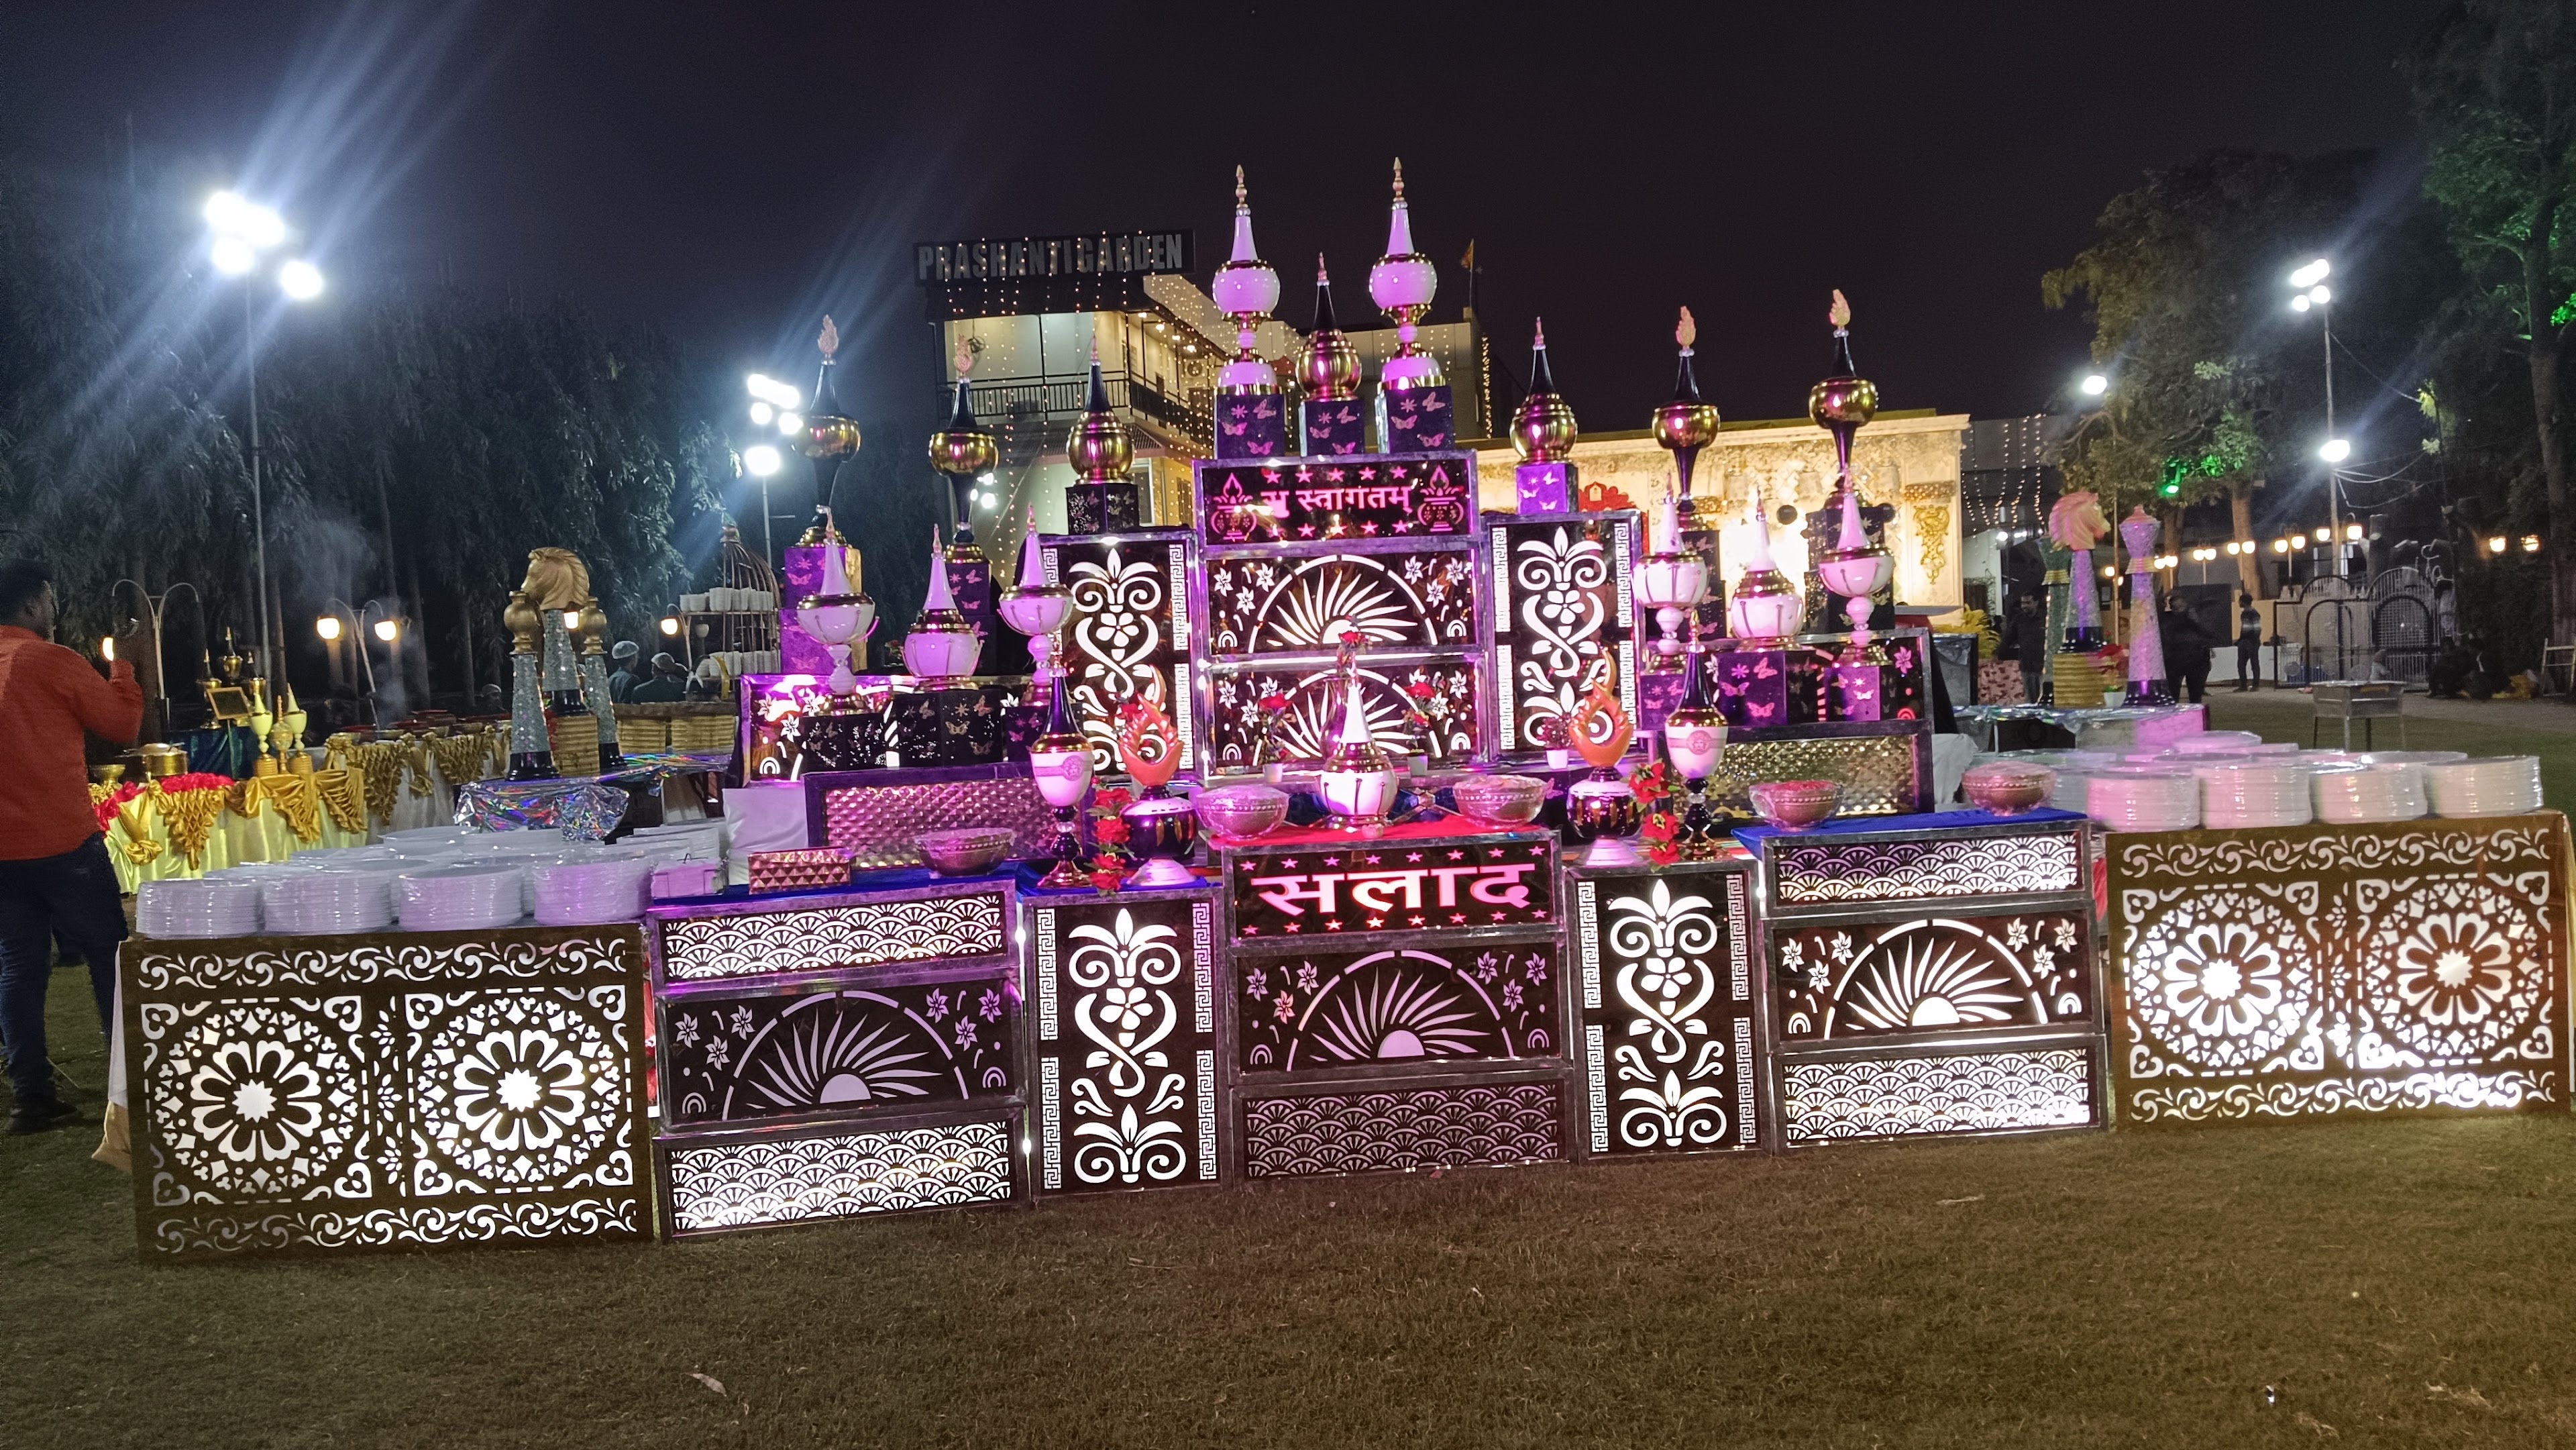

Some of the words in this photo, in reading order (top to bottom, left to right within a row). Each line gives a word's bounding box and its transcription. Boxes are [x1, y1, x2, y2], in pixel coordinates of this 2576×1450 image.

[918, 240, 1073, 280] PRASHANTI
[1078, 234, 1182, 273] GARDEN
[1251, 864, 1536, 917] सलाद
